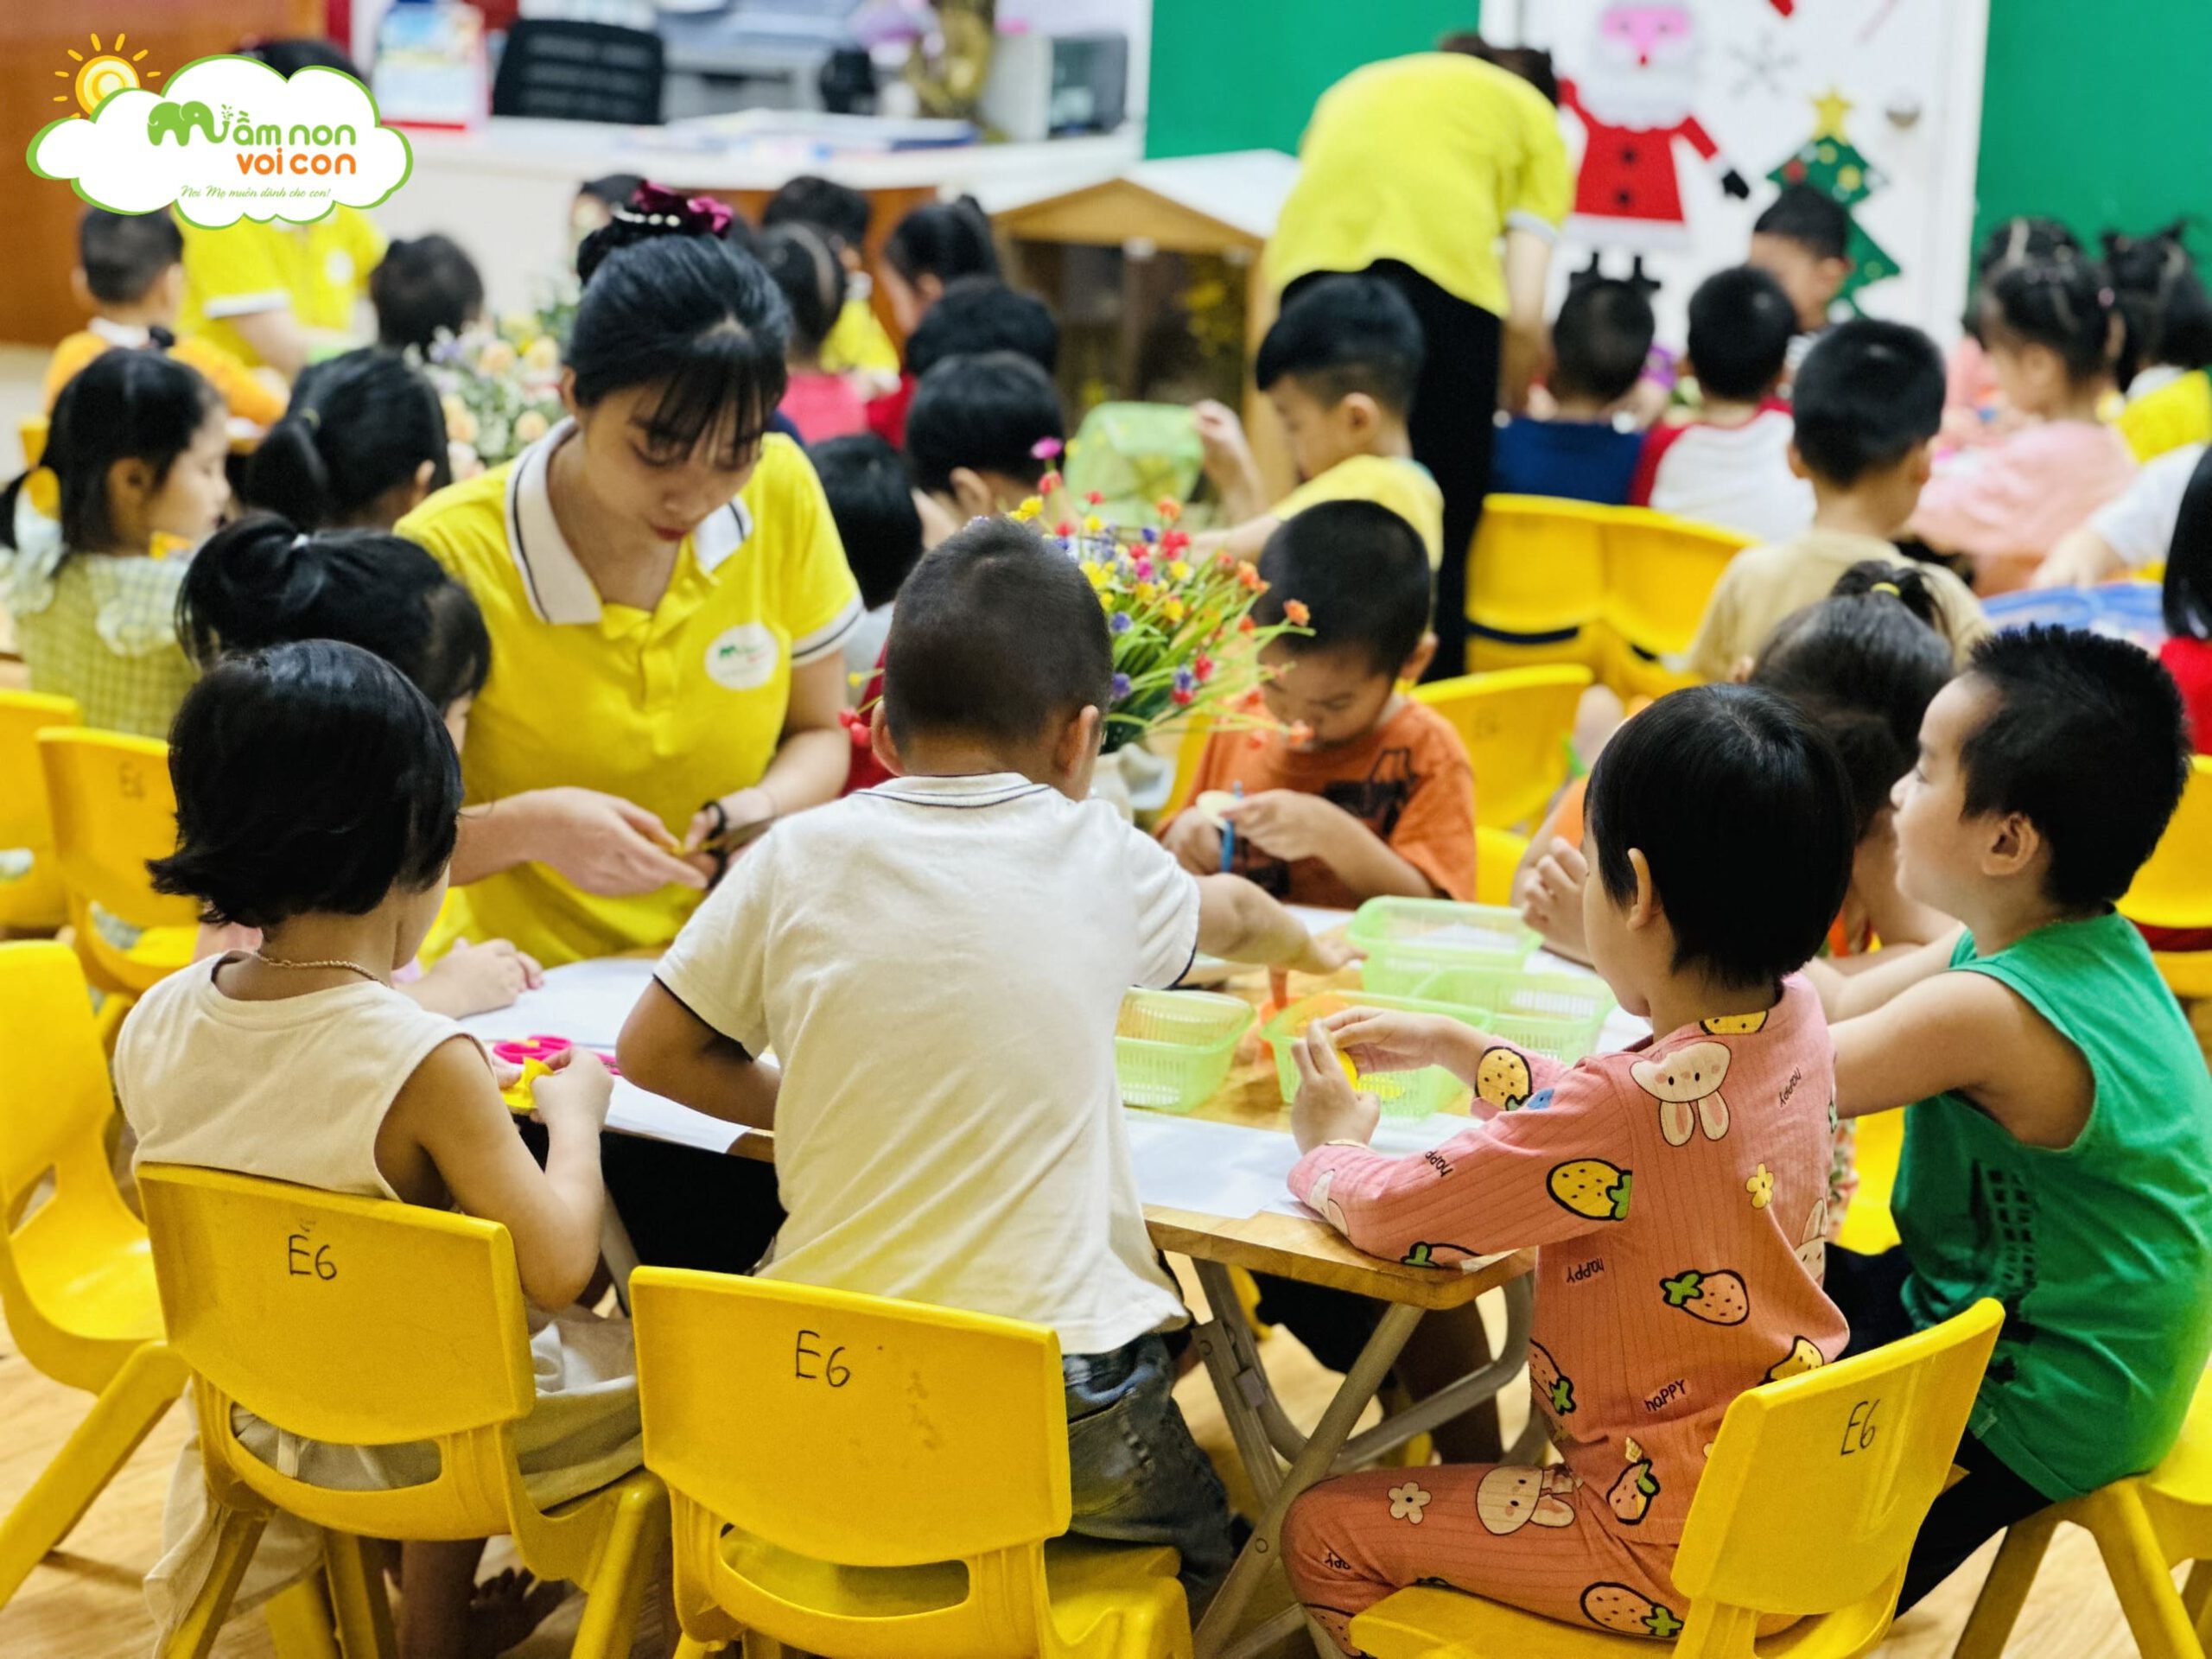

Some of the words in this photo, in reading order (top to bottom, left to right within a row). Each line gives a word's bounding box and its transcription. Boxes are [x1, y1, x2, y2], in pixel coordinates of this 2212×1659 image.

[289, 1233, 338, 1281] E6
[796, 1329, 851, 1388] E6
[1840, 1398, 1881, 1457] E6
